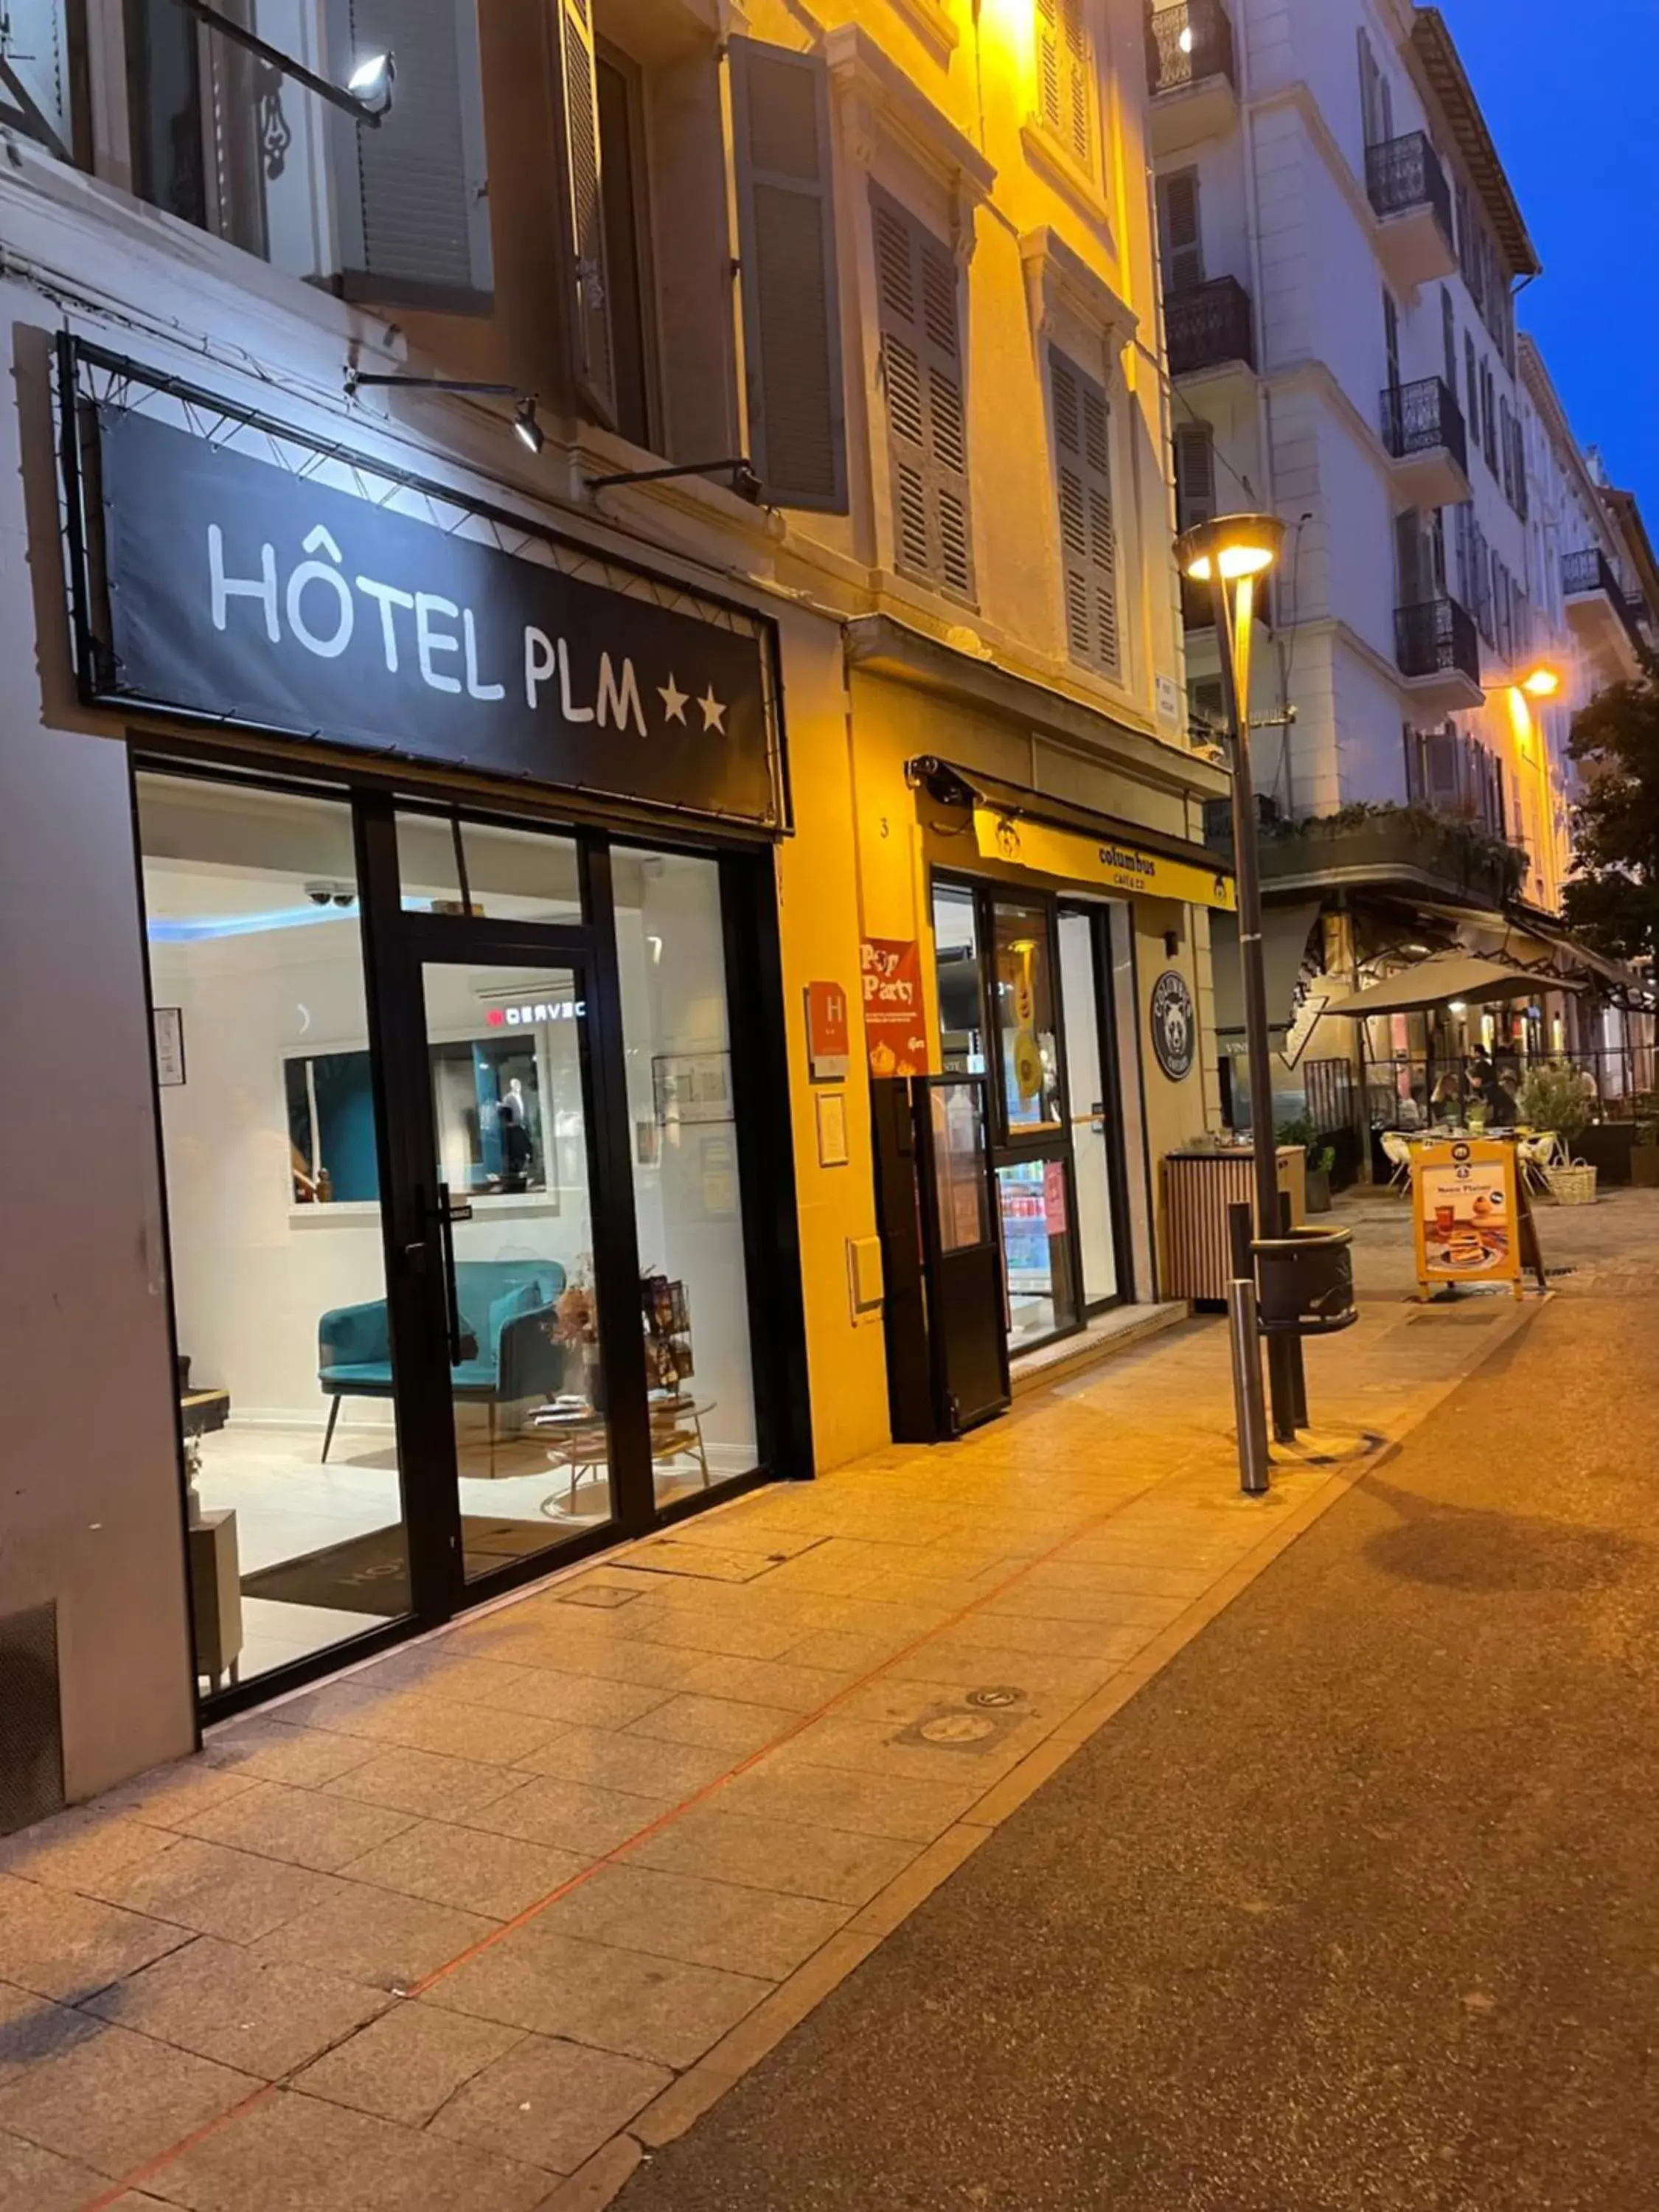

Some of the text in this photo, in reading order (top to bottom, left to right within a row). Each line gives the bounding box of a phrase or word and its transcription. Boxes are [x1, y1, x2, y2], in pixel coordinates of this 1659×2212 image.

[208, 524, 647, 737] HÔTEL PLM
[880, 817, 889, 838] 3
[1099, 846, 1155, 877] columbus
[860, 944, 900, 977] Pop
[862, 974, 914, 1006] Party
[827, 995, 843, 1023] H
